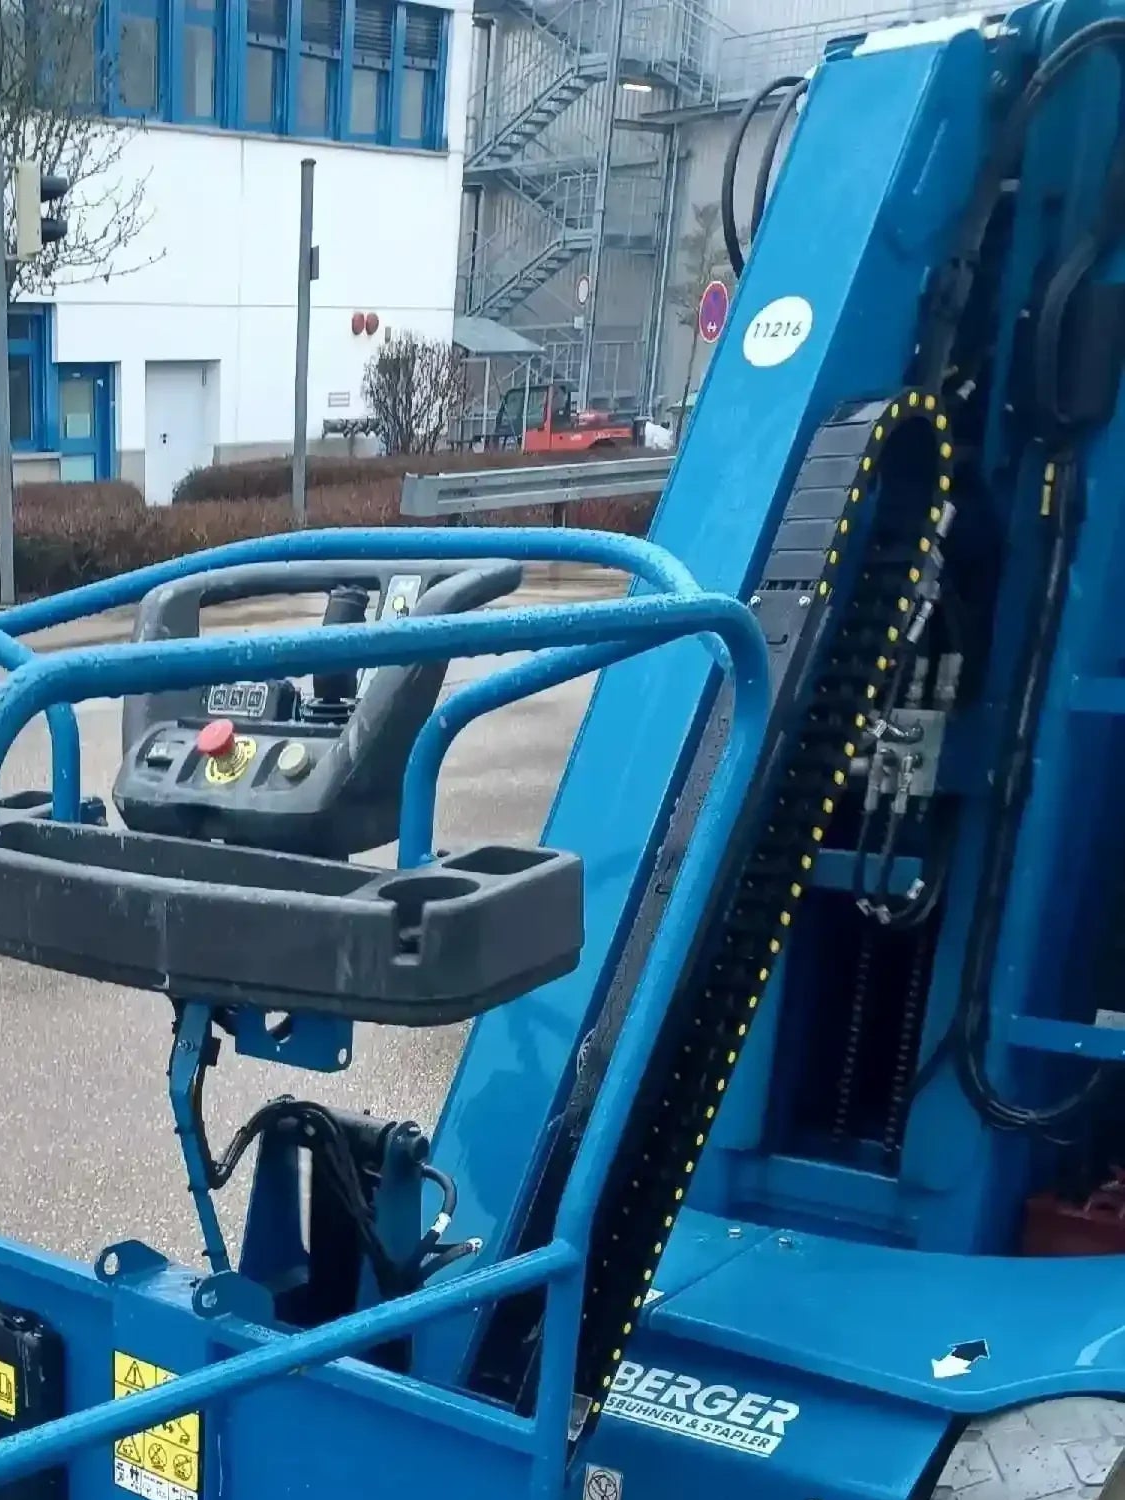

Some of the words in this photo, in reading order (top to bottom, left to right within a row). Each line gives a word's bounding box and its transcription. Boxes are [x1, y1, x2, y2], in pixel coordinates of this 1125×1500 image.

[753, 321, 803, 338] 11216
[685, 1417, 700, 1430] &
[699, 1422, 772, 1450] STAPLER
